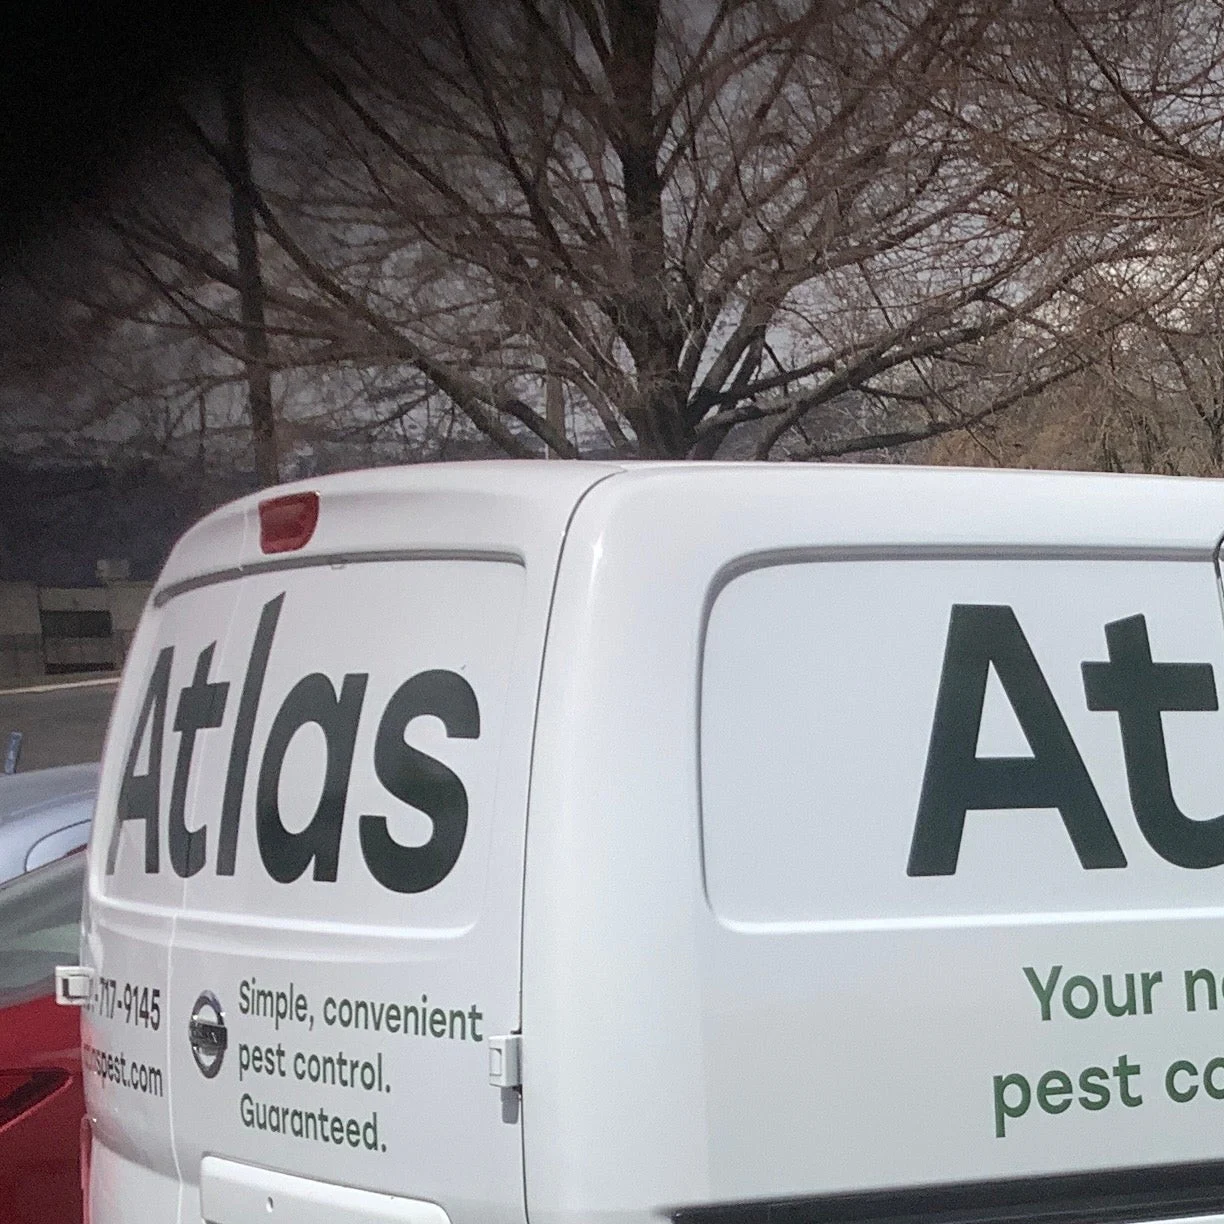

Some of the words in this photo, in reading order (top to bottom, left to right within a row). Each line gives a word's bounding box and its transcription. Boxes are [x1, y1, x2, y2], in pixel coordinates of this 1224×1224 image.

[105, 591, 482, 895] Atlas
[84, 976, 161, 1031] -717-9145
[238, 976, 315, 1032] Simple,
[323, 994, 484, 1043] convenient
[1022, 964, 1164, 1022] Your
[238, 1042, 287, 1082] pest
[293, 1051, 392, 1094] control.
[992, 1054, 1144, 1139] pest
[239, 1092, 388, 1153] Guaranteed.
